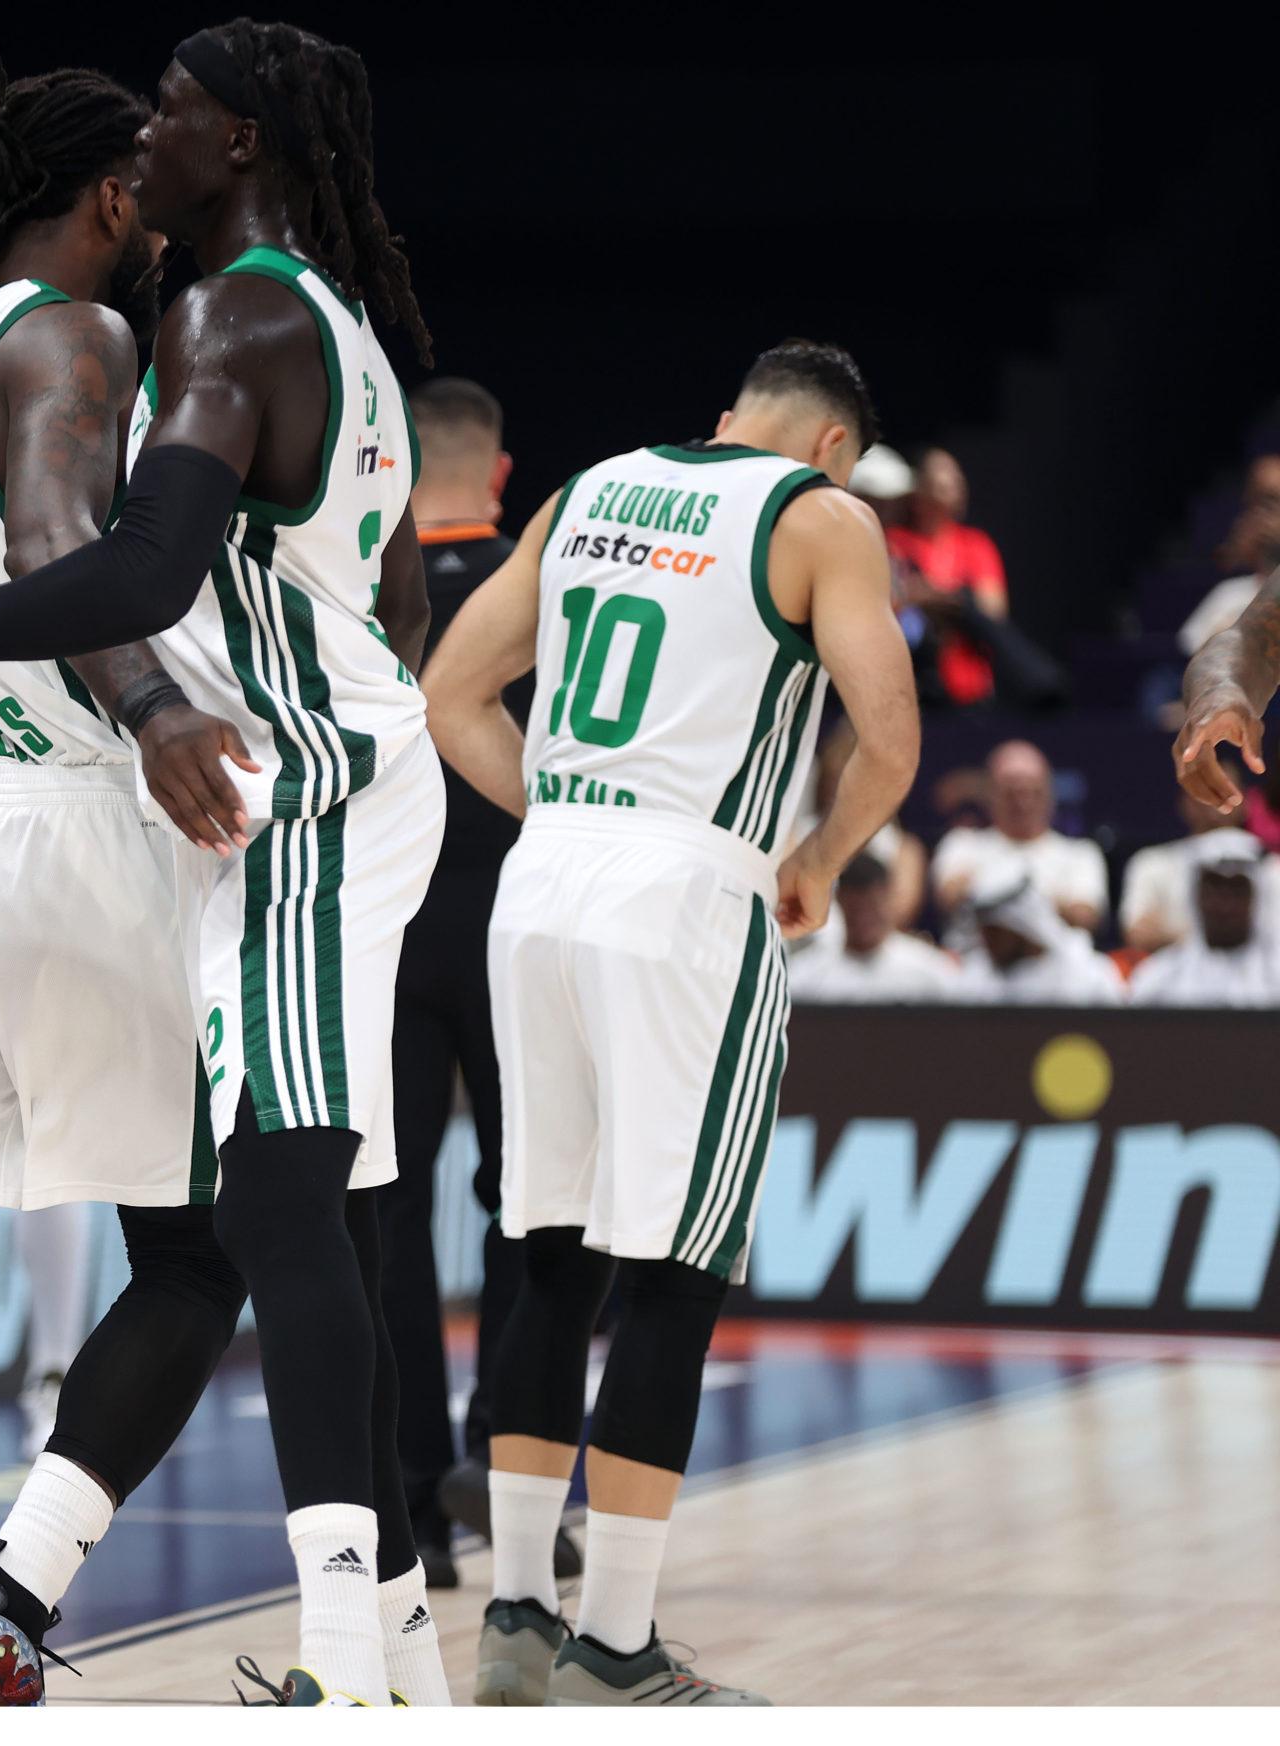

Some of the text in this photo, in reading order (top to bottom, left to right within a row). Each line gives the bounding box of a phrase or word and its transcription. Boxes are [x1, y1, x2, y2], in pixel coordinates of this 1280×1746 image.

[588, 482, 718, 536] SLOUKAS
[561, 527, 716, 577] instacar
[549, 586, 666, 748] 10
[749, 1033, 1280, 1311] win
[322, 1561, 369, 1576] adidas
